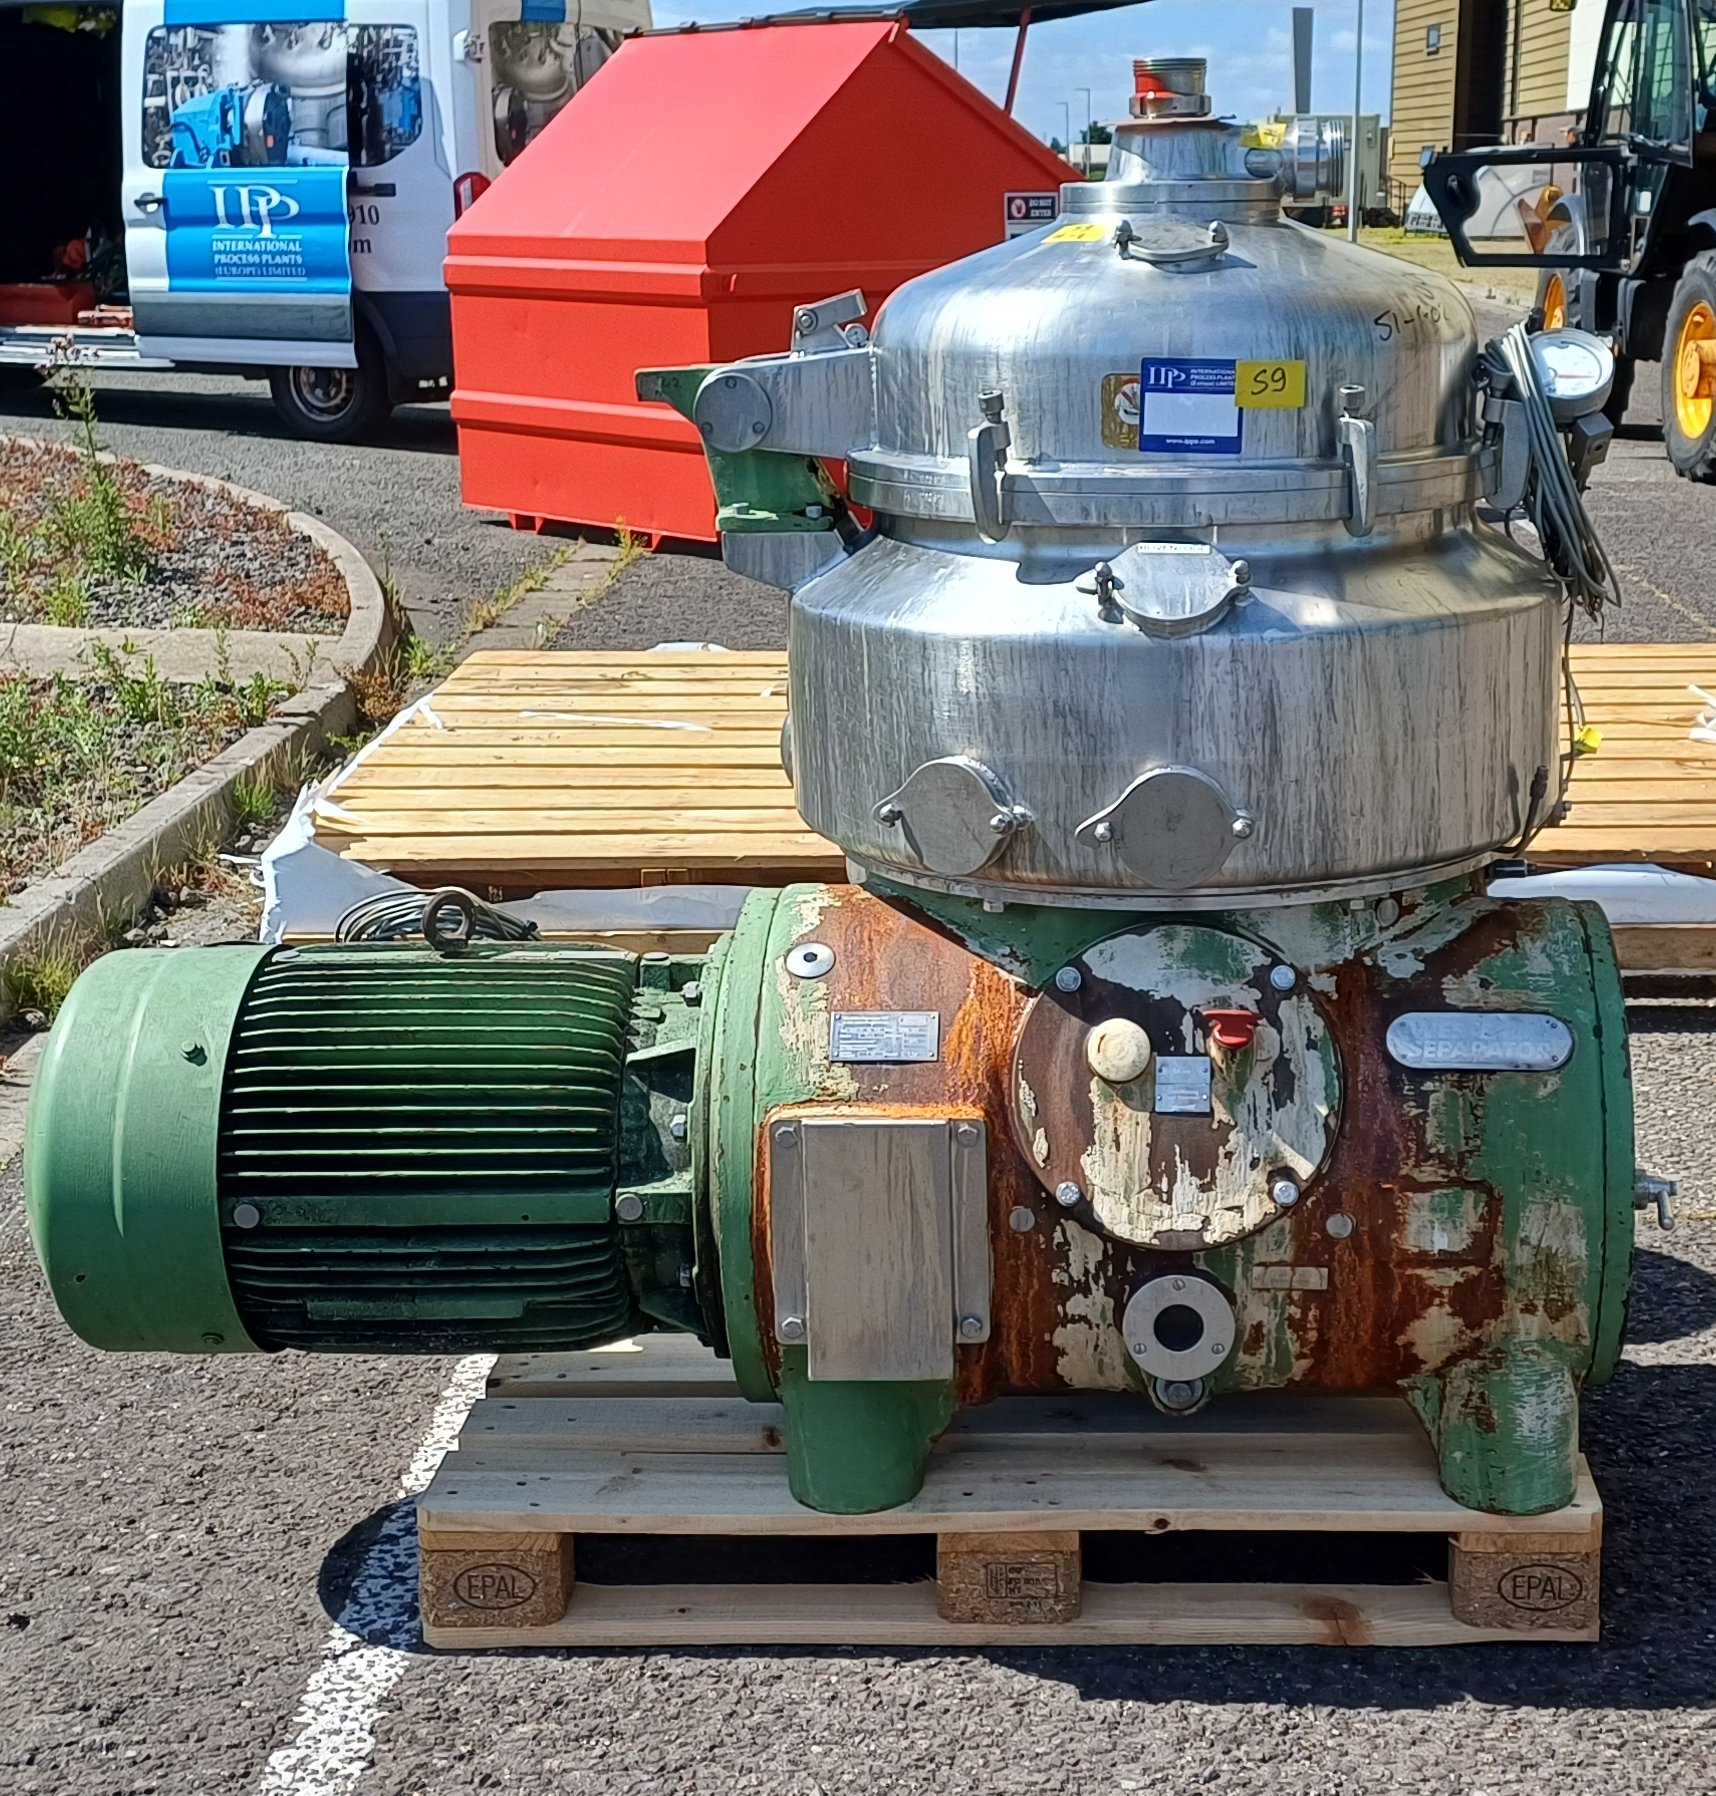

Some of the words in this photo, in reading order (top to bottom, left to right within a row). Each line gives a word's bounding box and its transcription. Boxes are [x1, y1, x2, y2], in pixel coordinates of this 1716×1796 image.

[208, 185, 300, 238] IPP
[212, 240, 303, 252] INTERNATIONAL
[214, 253, 260, 265] PROCESS
[261, 254, 303, 265] PLANTS
[467, 1575, 525, 1600] EPAL
[1512, 1575, 1571, 1600] EPAL
